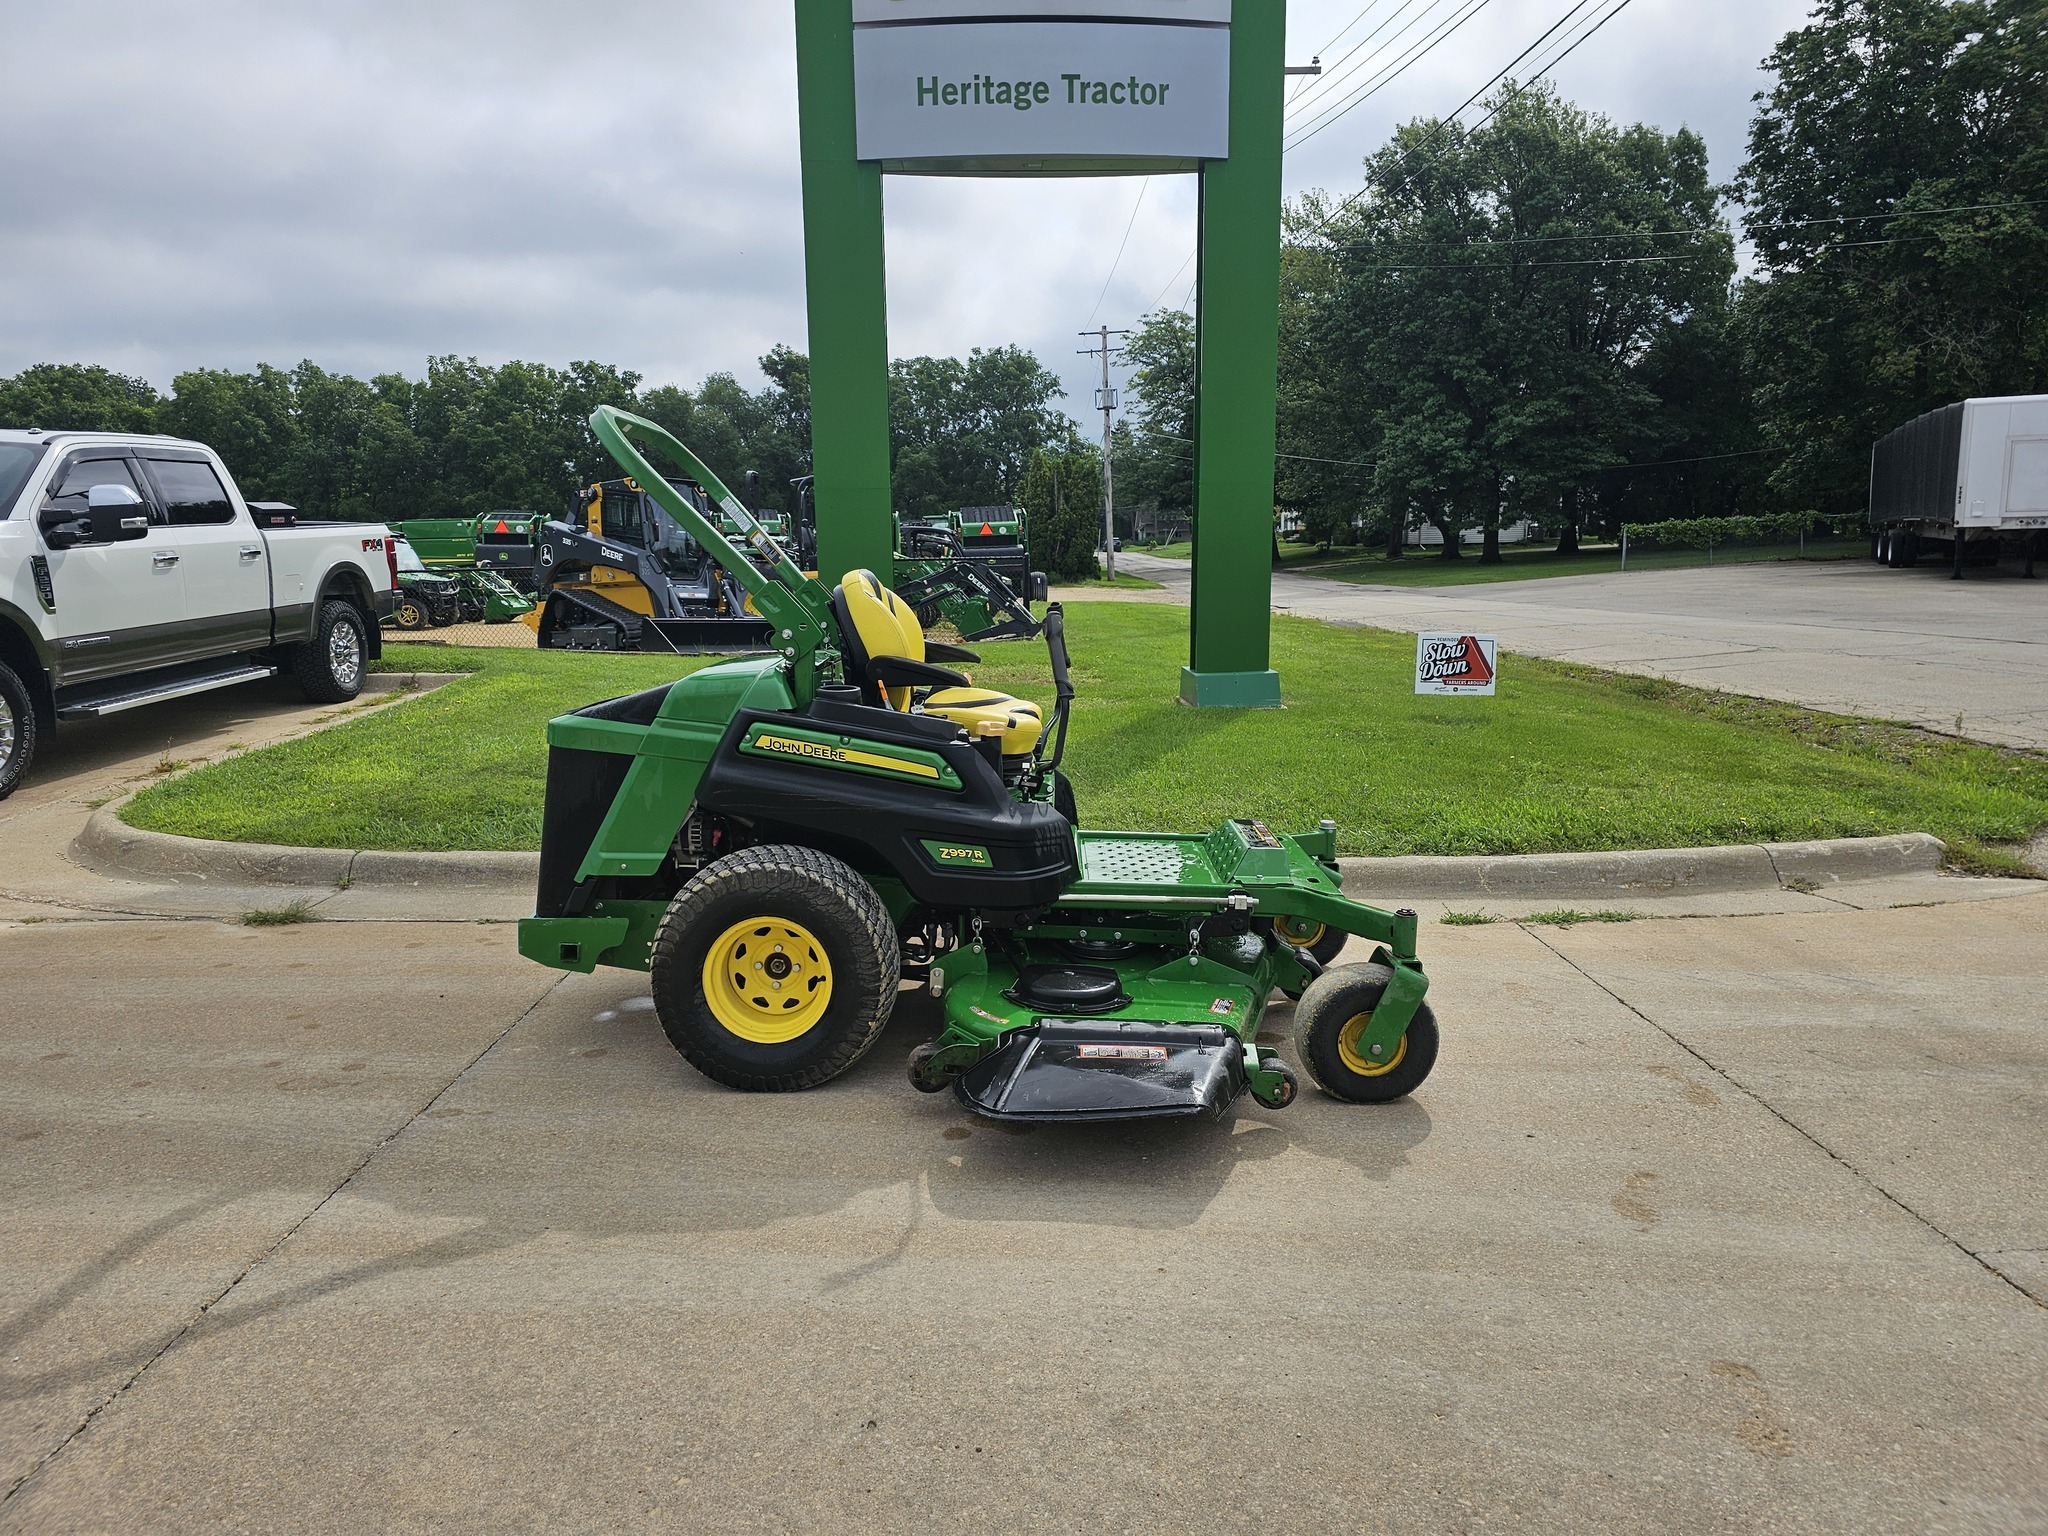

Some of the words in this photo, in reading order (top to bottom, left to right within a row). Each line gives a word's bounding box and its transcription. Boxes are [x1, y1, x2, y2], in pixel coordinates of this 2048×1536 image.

[916, 74, 1050, 111] Heritage
[1061, 73, 1170, 105] Tractor
[361, 538, 383, 552] FX4
[601, 546, 624, 562] DEERE
[967, 573, 991, 595] DEERE
[1424, 643, 1469, 662] Slow
[1419, 660, 1472, 680] Down
[764, 738, 801, 754] JOHN
[803, 743, 847, 761] DEERE
